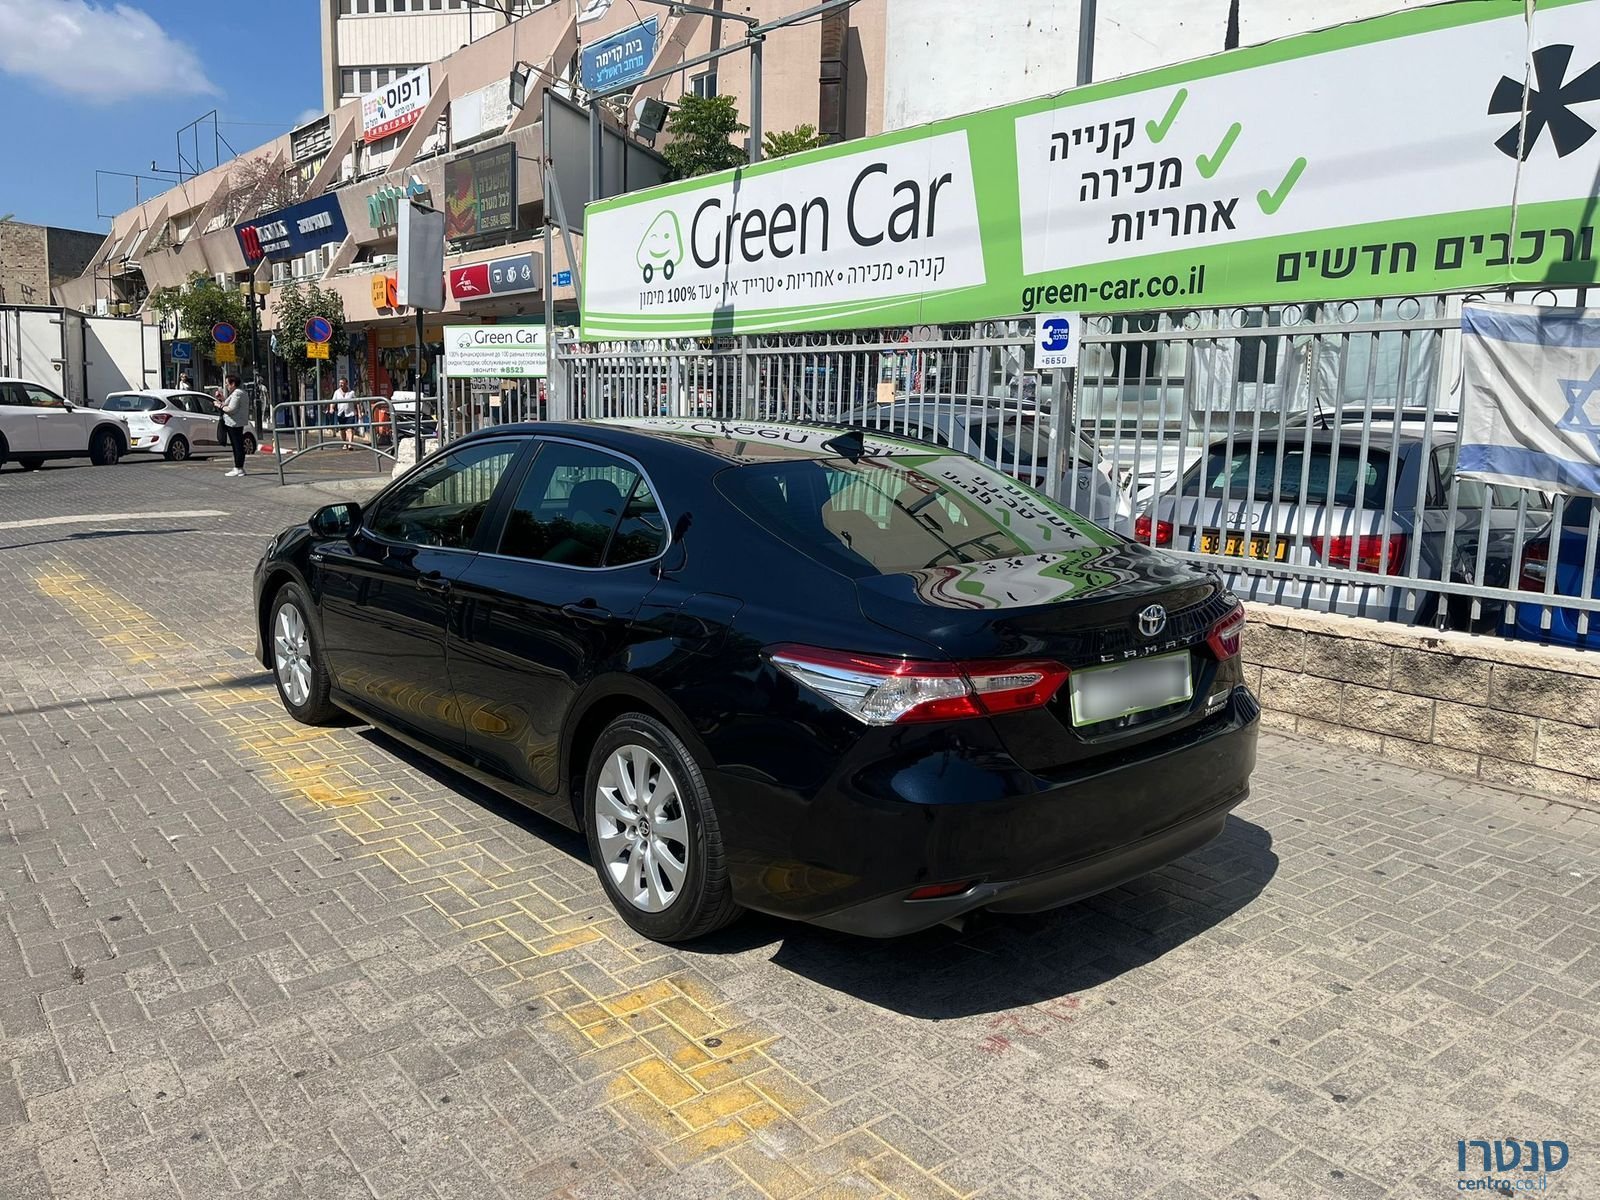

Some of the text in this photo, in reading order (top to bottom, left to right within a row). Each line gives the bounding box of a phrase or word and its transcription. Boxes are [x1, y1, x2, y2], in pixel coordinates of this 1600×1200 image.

[595, 38, 643, 68] בית קדימה
[623, 54, 644, 71] מרחב
[387, 76, 421, 109] דפוס
[1050, 117, 1135, 162] קנייה
[1080, 157, 1182, 202] מכירה
[691, 162, 952, 269] Green Car
[1108, 197, 1239, 244] אחריות
[1275, 226, 1594, 284] ורכבים חדשים
[786, 269, 834, 291] אחריות
[847, 262, 893, 284] מכירה
[908, 256, 945, 281] קניה
[667, 285, 697, 303] 100%
[698, 284, 713, 300] עד
[742, 276, 774, 295] טרייד
[1022, 265, 1206, 313] green-car.co.il
[639, 289, 664, 310] מימון
[474, 329, 538, 344] Green Car
